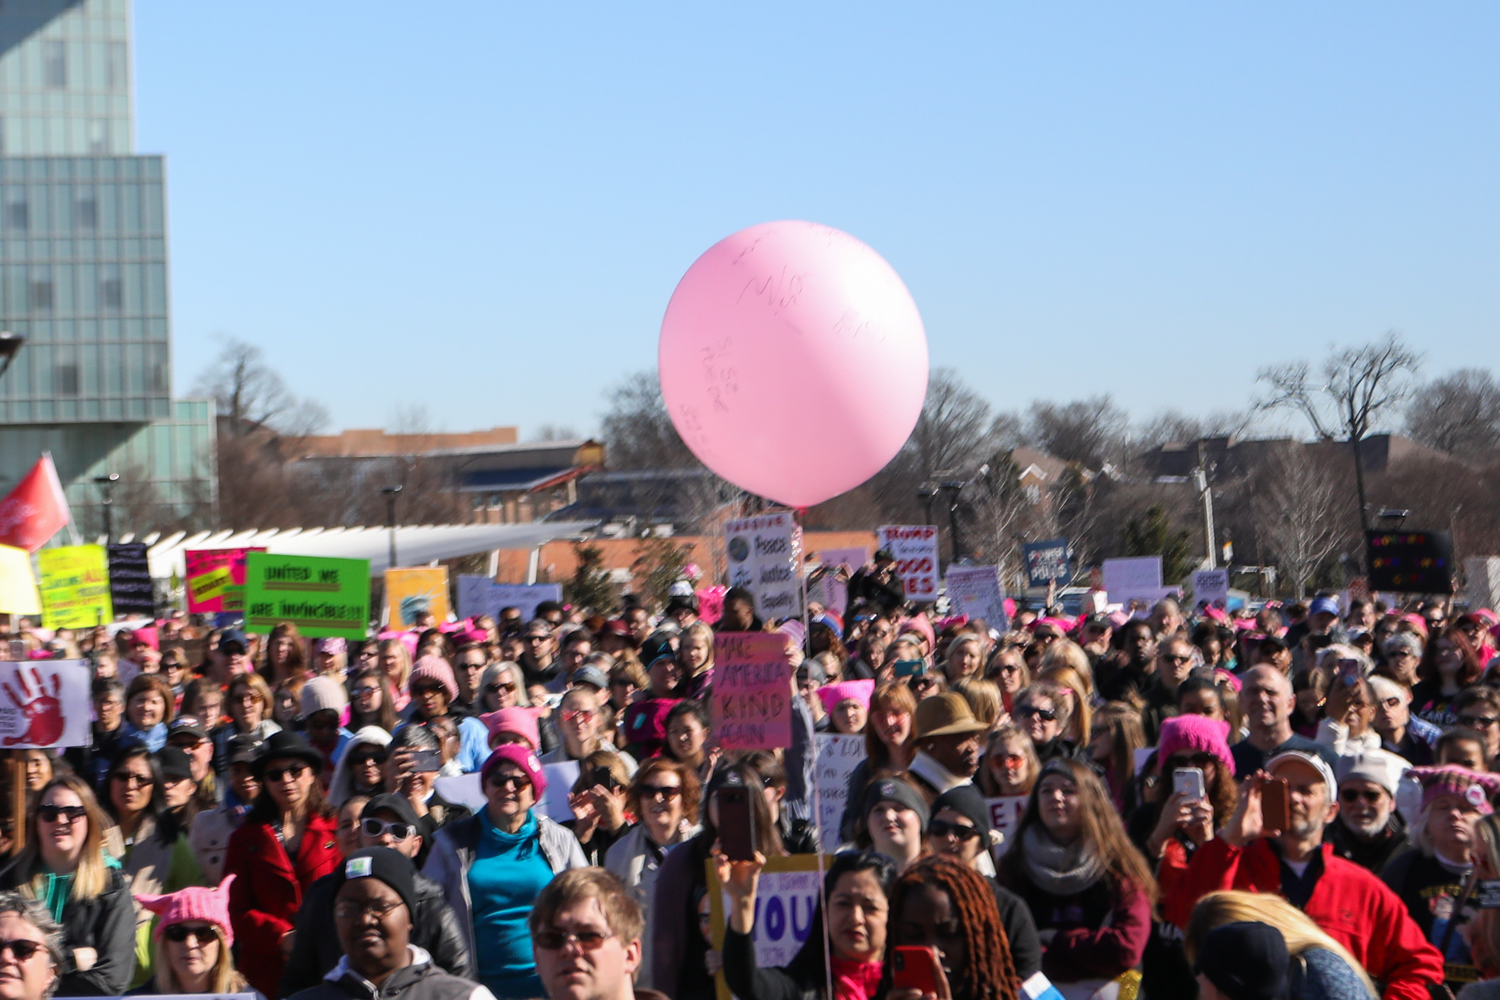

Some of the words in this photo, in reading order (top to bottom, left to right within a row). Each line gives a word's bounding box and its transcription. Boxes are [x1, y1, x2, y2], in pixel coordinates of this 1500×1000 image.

[884, 527, 936, 541] TRUMP
[1028, 546, 1065, 563] POWER
[896, 556, 934, 577] 000
[1031, 562, 1068, 582] POLLS
[901, 577, 934, 594] IES
[251, 602, 275, 618] ARE
[714, 634, 754, 660] MAKE
[720, 662, 787, 687] AMERICA
[721, 691, 785, 719] KIND
[720, 722, 766, 745] AGAIN
